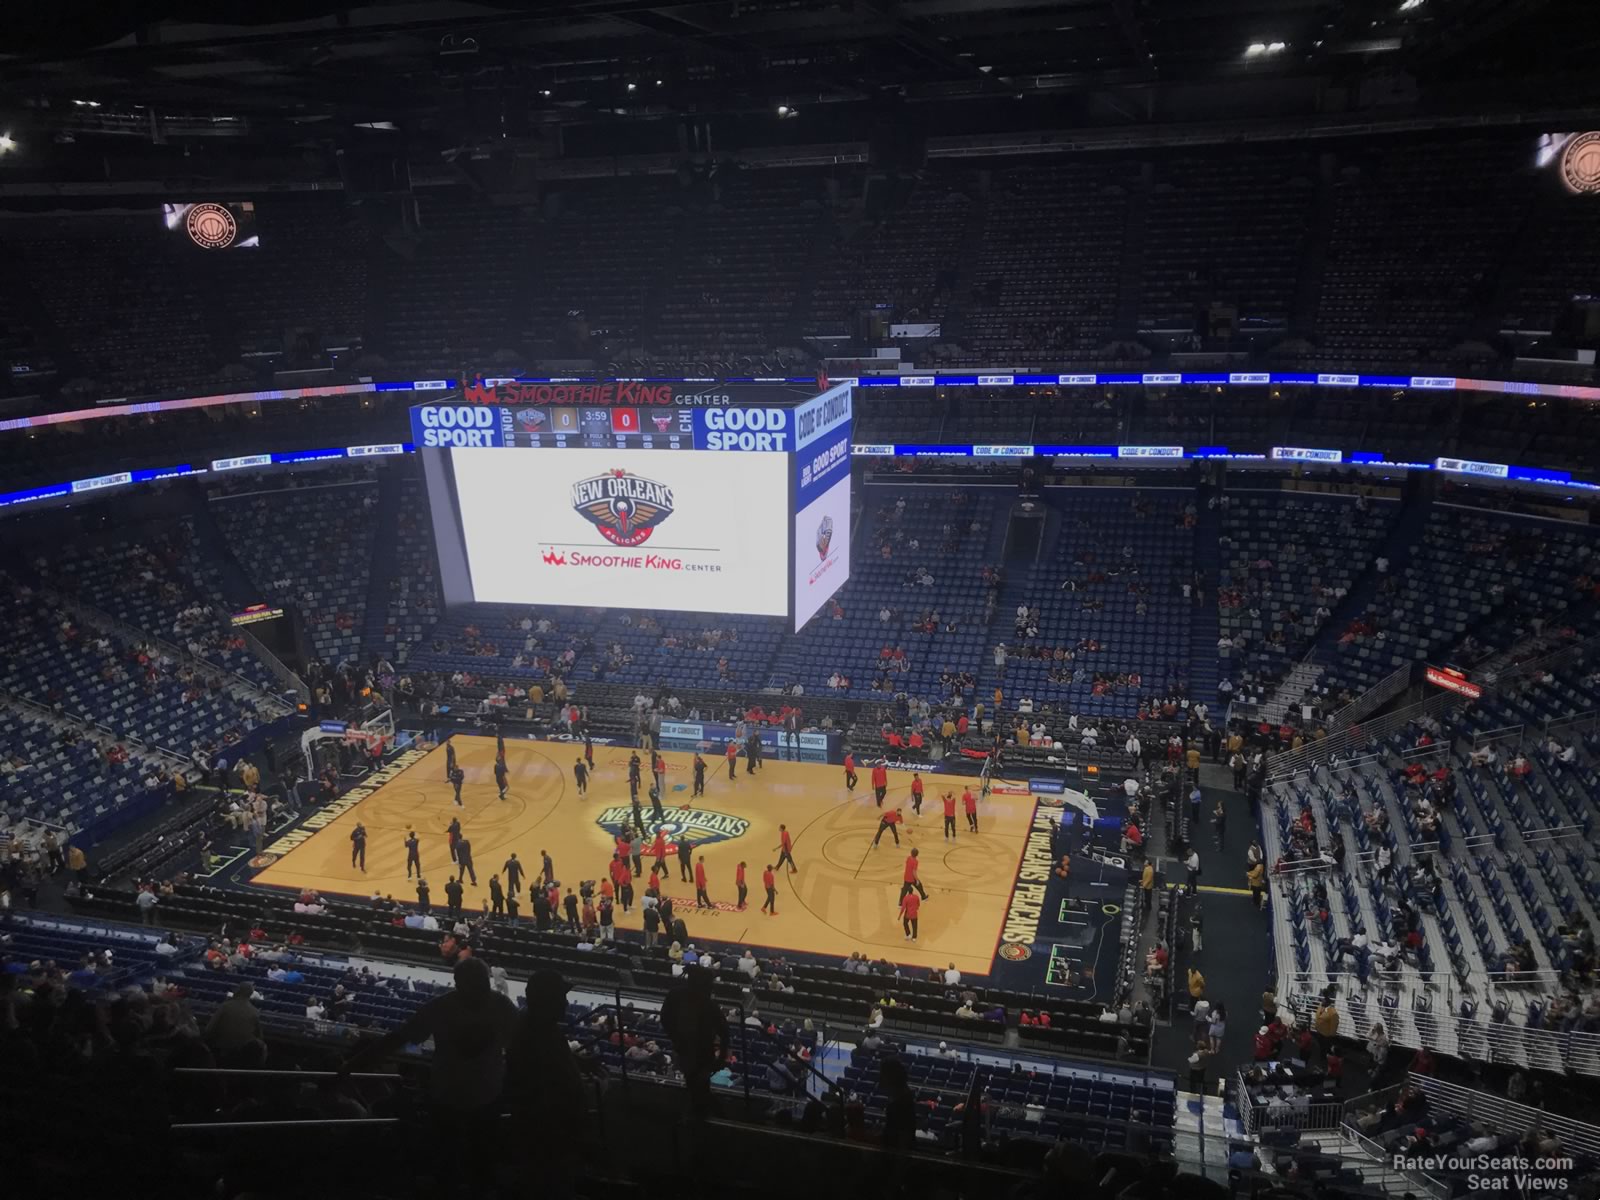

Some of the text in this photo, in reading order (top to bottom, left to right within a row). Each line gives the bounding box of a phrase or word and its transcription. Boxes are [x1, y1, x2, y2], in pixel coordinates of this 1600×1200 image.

[505, 382, 612, 406] SMOOTHIE
[675, 394, 730, 405] CENTER
[420, 406, 494, 428] GOOD
[501, 408, 514, 432] NOP
[562, 414, 570, 426] 0
[586, 411, 607, 420] 3:59
[622, 414, 630, 427] 0
[678, 410, 692, 432] CHI
[704, 408, 787, 431] GOOD
[798, 406, 815, 441] CODE
[823, 390, 849, 426] CONDUCT
[423, 429, 495, 448] SPORT
[706, 432, 788, 450] SPORT
[813, 450, 830, 474] GOOD
[830, 438, 848, 463] SPORT
[864, 446, 892, 454] CONDUCT
[976, 446, 992, 455] CODE
[1000, 446, 1031, 455] CONDUCT
[1122, 448, 1140, 456] CODE
[1149, 448, 1180, 456] CONDUCT
[1276, 448, 1296, 458] CODE
[1305, 450, 1339, 460] CONDUCT
[1441, 460, 1459, 470] CODE
[1470, 462, 1505, 475] CONDUCT
[570, 478, 675, 508] NEW ORLEANS
[605, 530, 646, 544] PELICANS
[570, 552, 642, 568] SMOOTHIE
[685, 564, 722, 572] CENTER
[678, 726, 701, 736] CONDUCT
[800, 736, 825, 746] CONDUCT
[263, 749, 428, 855] NEW ORLEANS PELICANS
[663, 807, 750, 836] ORLEANS
[1018, 831, 1053, 882] ORLEANS
[672, 906, 720, 916] ENTER
[1002, 882, 1047, 945] PELICANS
